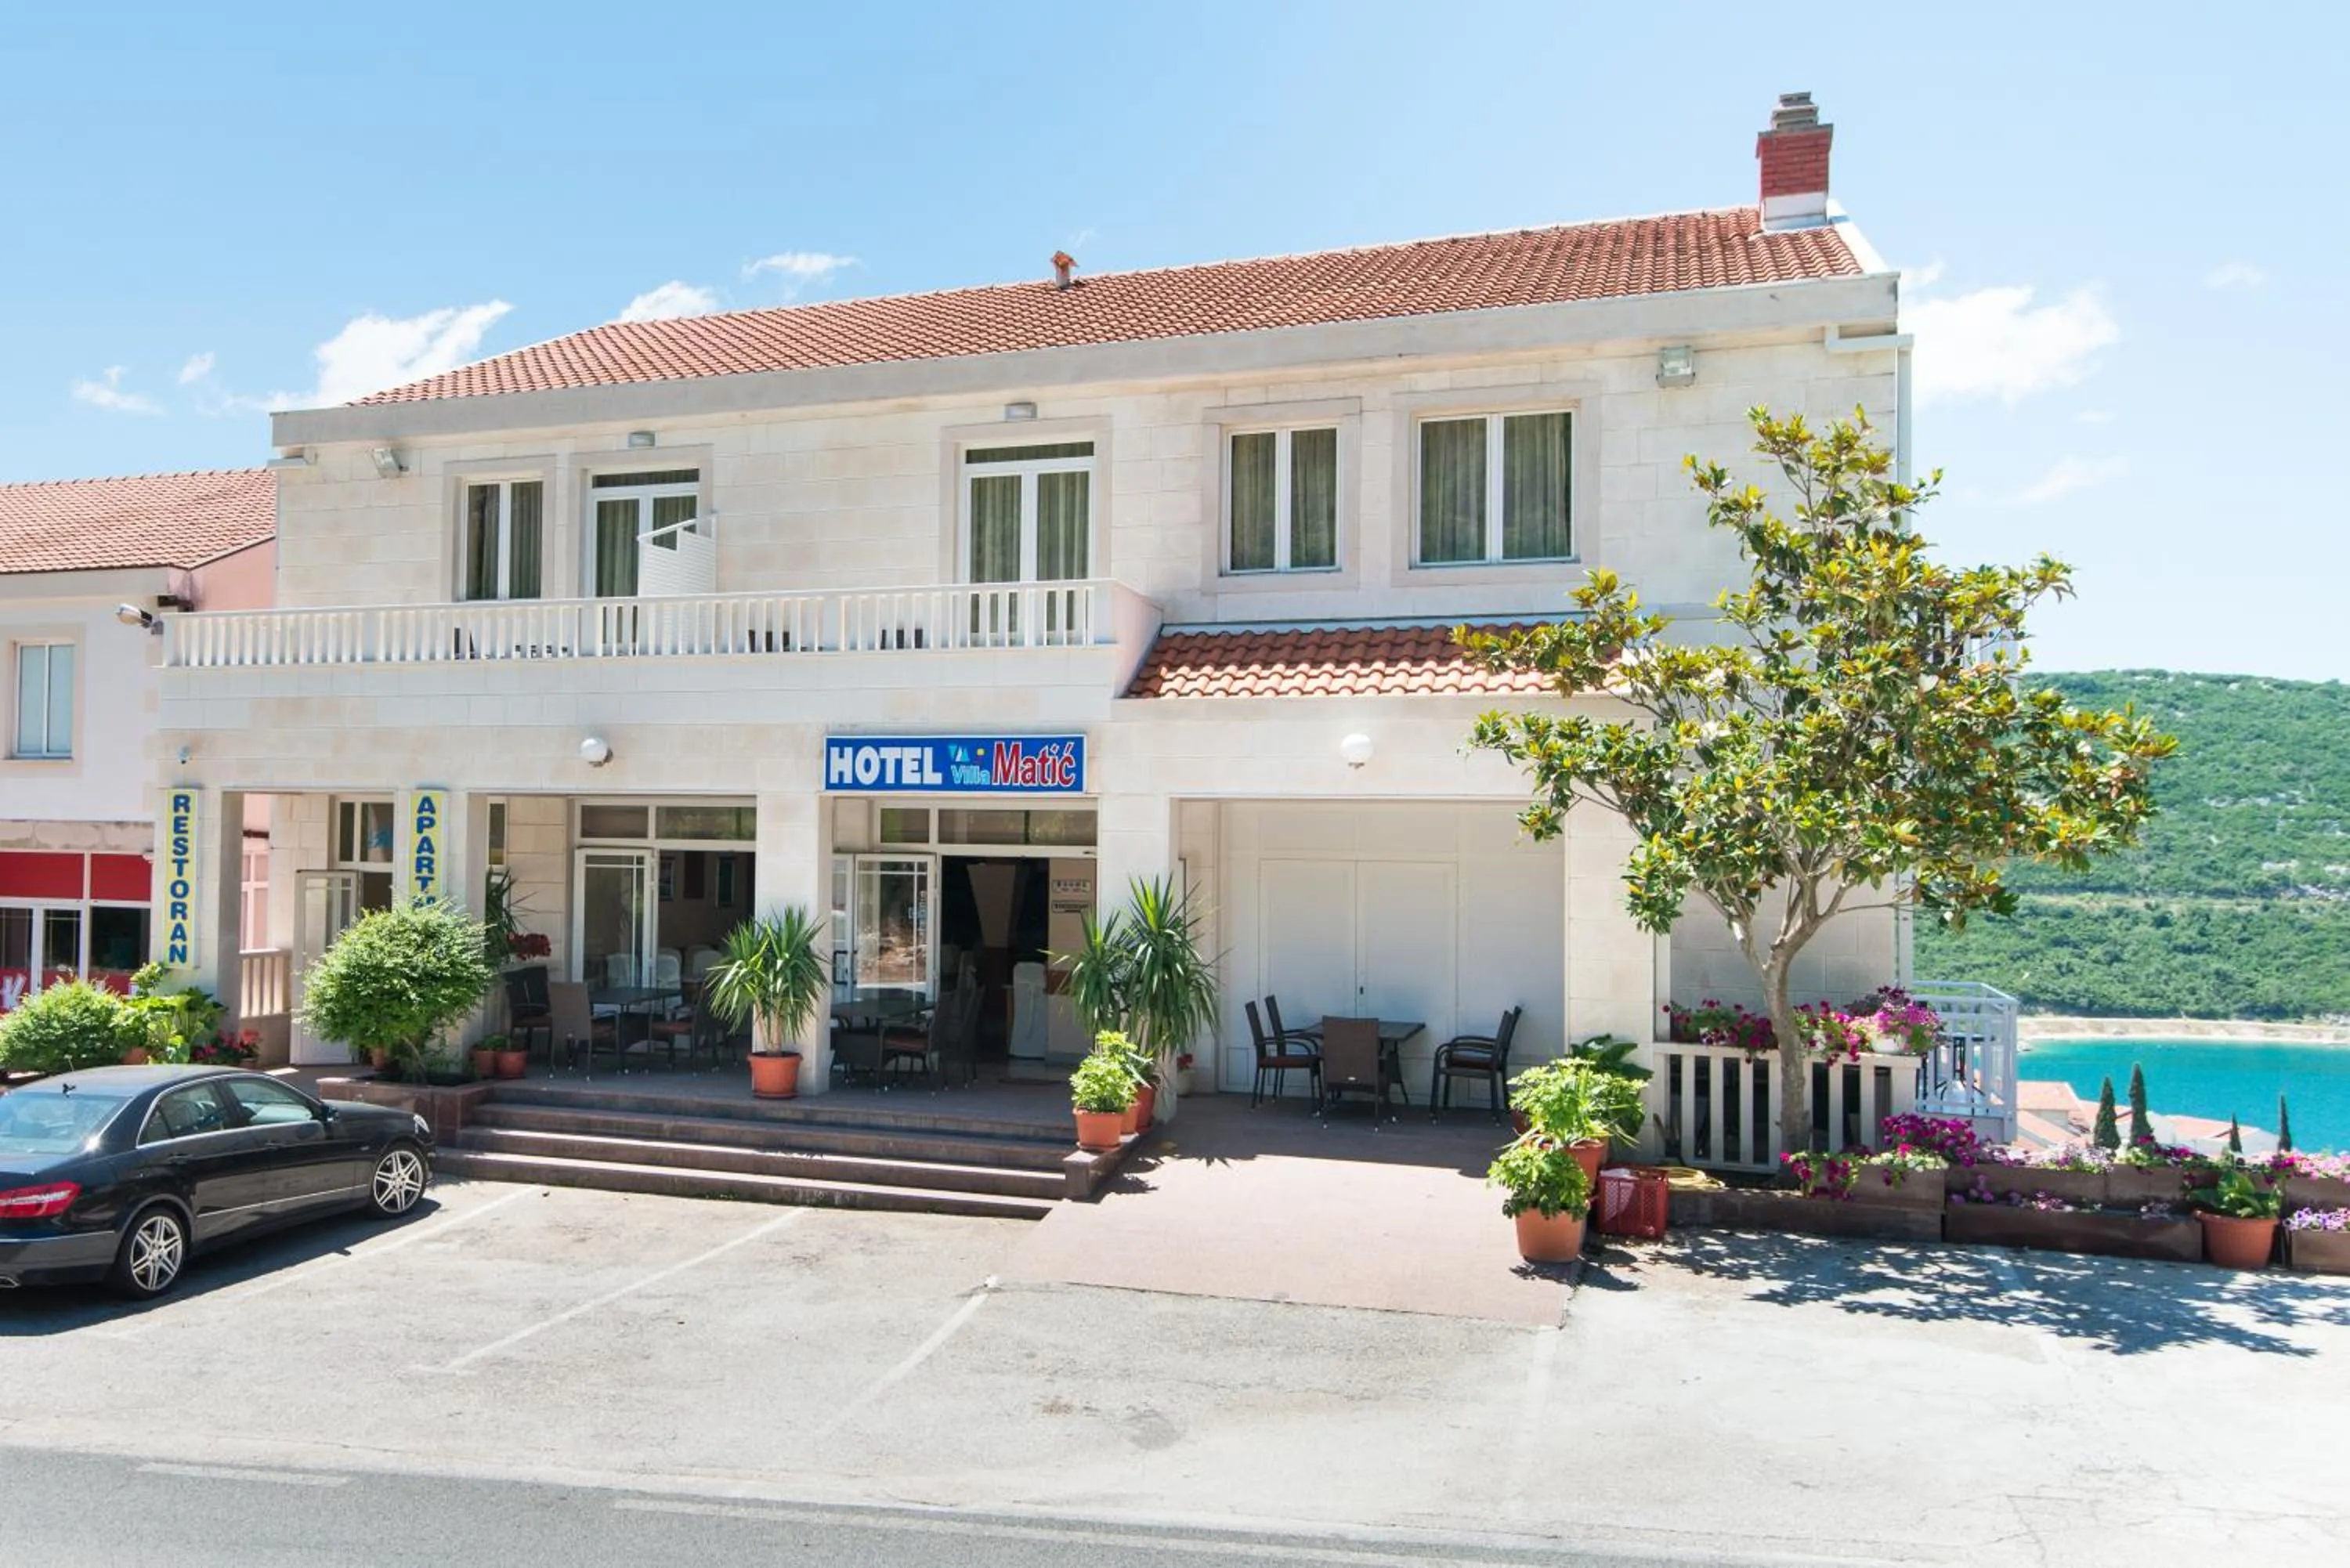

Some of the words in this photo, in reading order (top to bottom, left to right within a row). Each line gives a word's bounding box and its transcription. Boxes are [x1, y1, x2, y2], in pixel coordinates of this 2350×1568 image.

[829, 746, 942, 786] HOTEL
[950, 764, 991, 786] Villa
[992, 741, 1076, 787] Matić
[168, 794, 190, 963] RESTORAN
